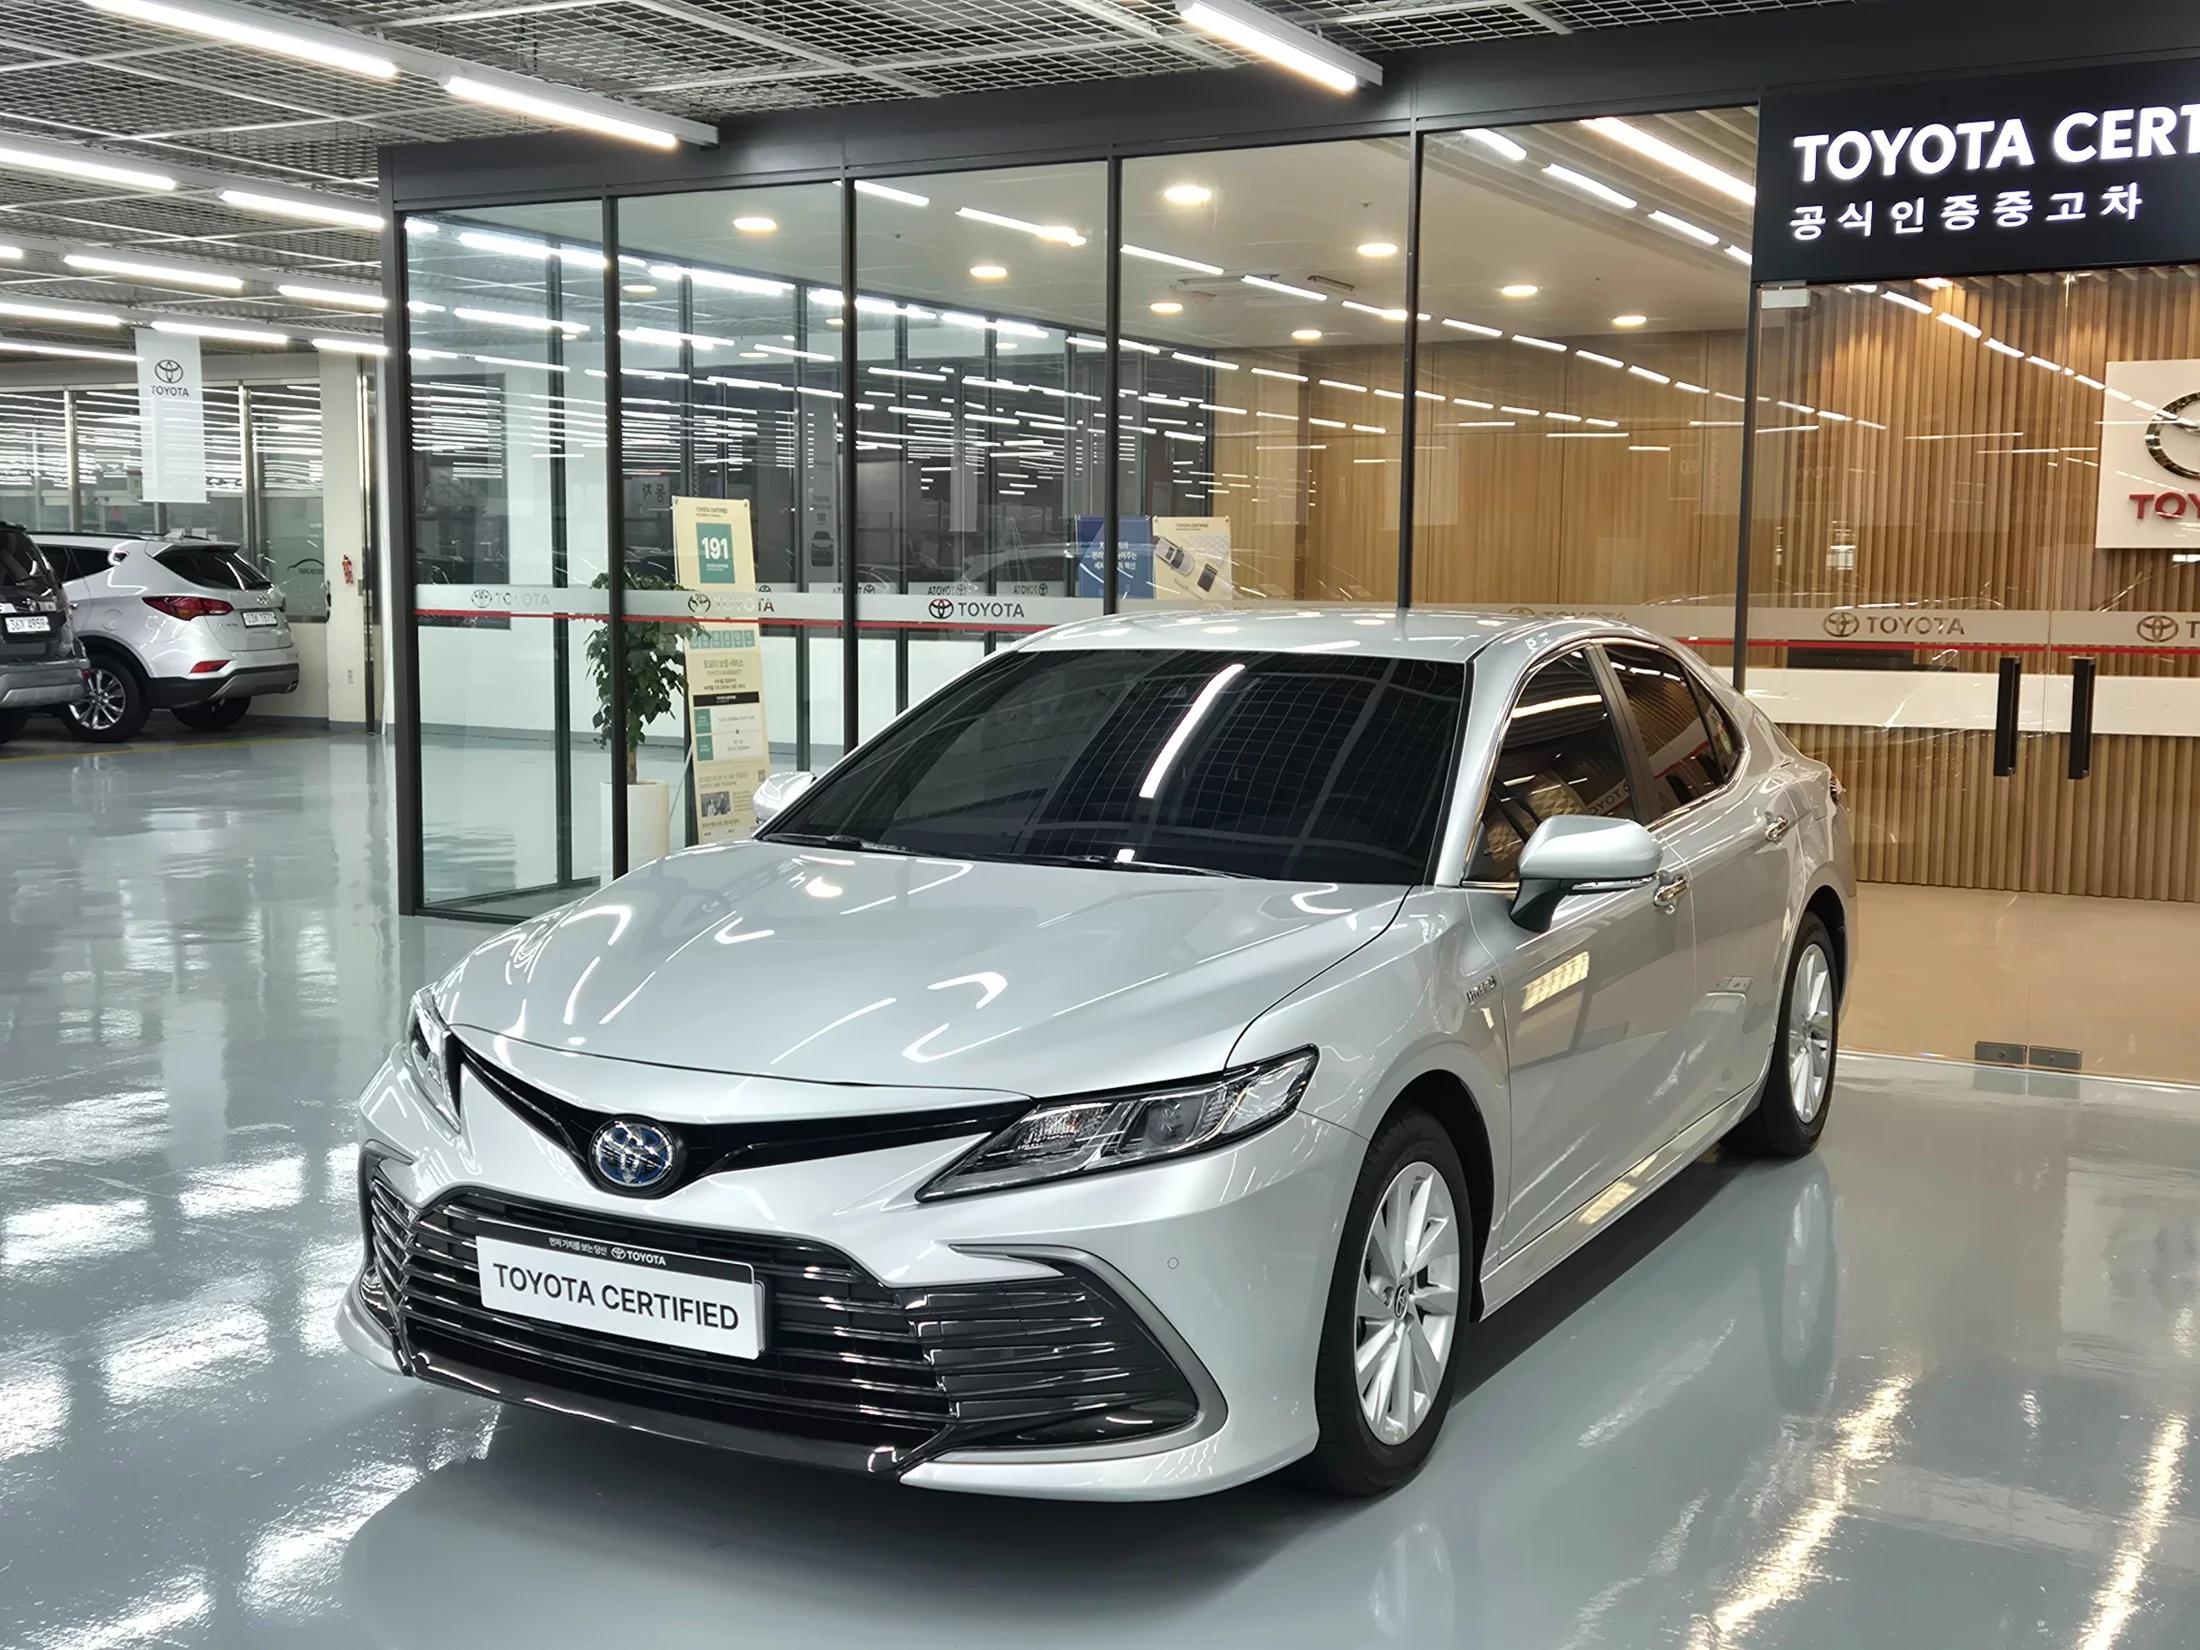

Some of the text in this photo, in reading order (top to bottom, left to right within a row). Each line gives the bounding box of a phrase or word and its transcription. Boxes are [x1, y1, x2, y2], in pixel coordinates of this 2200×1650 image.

[1793, 103, 2200, 183] TOYOTA CERT
[151, 385, 190, 397] TOYOTA
[701, 537, 729, 560] 191
[958, 602, 1025, 618] TOYOTA
[1867, 616, 1965, 635] TOYOTA
[627, 1251, 667, 1266] TOYOTA
[493, 1263, 739, 1330] TOYOTA CERTIFIED
